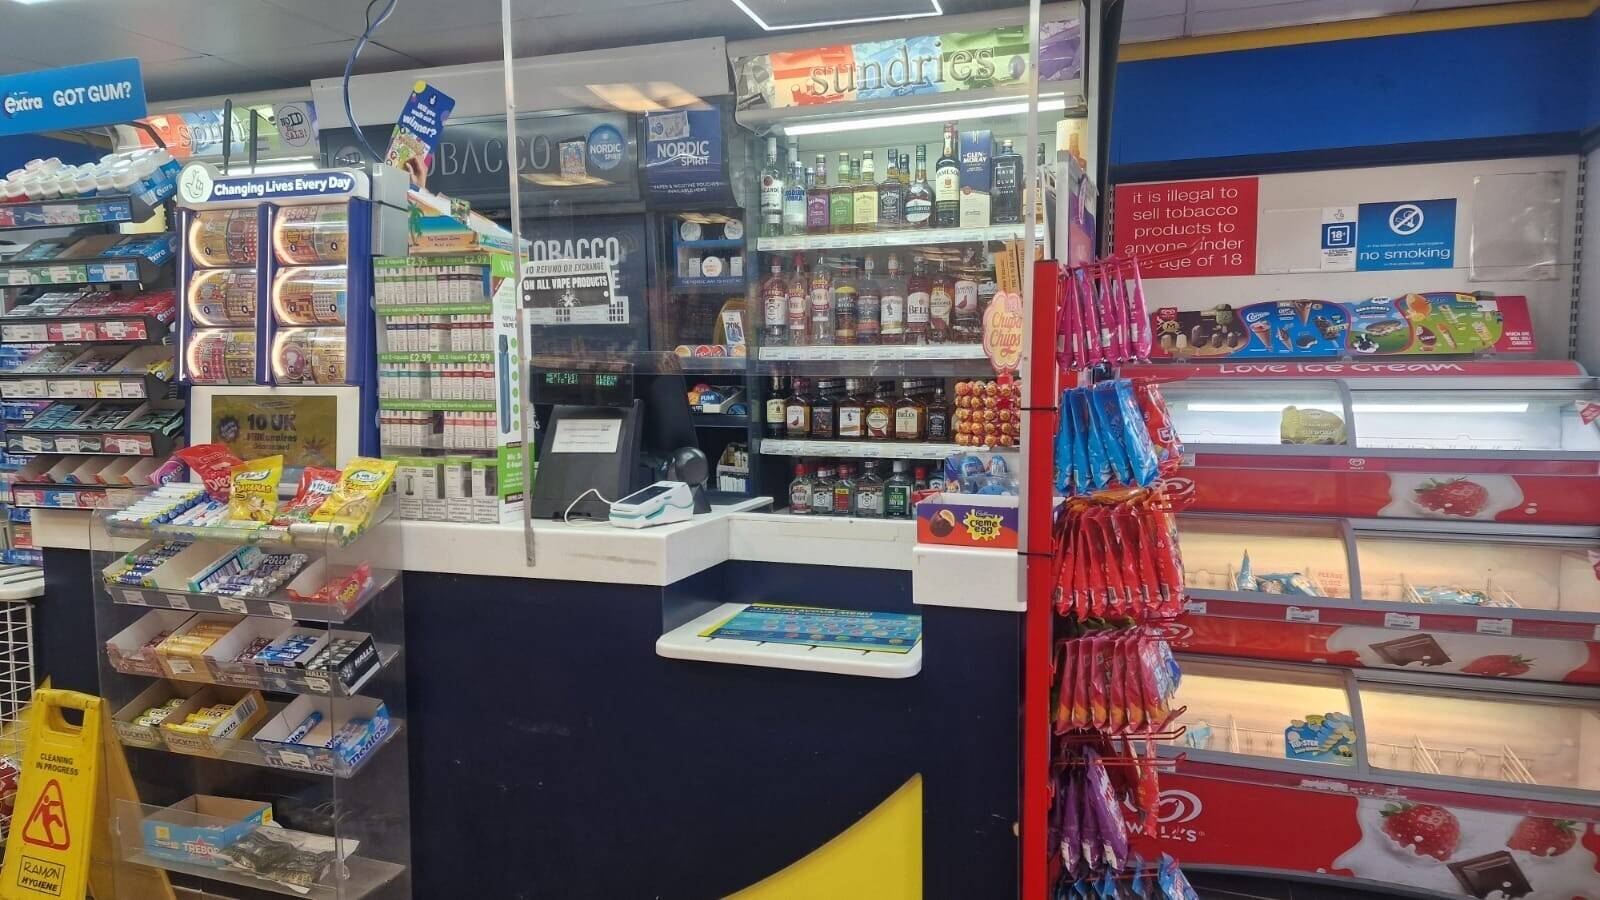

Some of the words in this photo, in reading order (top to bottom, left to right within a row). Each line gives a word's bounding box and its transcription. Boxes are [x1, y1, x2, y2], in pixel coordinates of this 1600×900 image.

[808, 40, 995, 95] sundries
[5, 95, 43, 114] extra
[53, 87, 85, 107] GOT
[88, 81, 131, 103] GUM?
[402, 115, 437, 138] winner?
[590, 143, 621, 154] NORDIC
[657, 141, 709, 158] NORDIC
[680, 156, 709, 166] SPIRIT
[214, 182, 264, 197] Changing
[265, 180, 294, 194] Lives
[295, 177, 327, 192] Every
[328, 176, 351, 190] Day
[1133, 192, 1142, 203] it
[1148, 191, 1161, 203] is
[1167, 187, 1214, 203] illegal
[1220, 188, 1238, 199] to
[1133, 208, 1159, 221] sell
[1166, 206, 1238, 219] tobacco
[1134, 223, 1212, 240] products
[1218, 221, 1235, 233] to
[1125, 242, 1187, 256] anyone
[1360, 252, 1379, 260] no
[1385, 248, 1450, 260] smoking
[1197, 255, 1215, 267] of
[1223, 253, 1242, 266] 18
[536, 264, 562, 274] REFUND
[574, 262, 604, 272] EXCHANGE
[523, 280, 535, 290] ON
[536, 279, 551, 290] ALL
[552, 278, 571, 289] VAPE
[572, 276, 608, 289] PRODUCTS
[990, 330, 1021, 347] Chups
[409, 354, 431, 363] £2.99
[467, 353, 490, 363] £2.99
[271, 413, 297, 431] UK
[974, 526, 993, 535] egg
[354, 643, 375, 667] HALLS
[264, 666, 286, 674] HALLS
[349, 725, 388, 767] mentos
[40, 753, 74, 765] CLEANING
[43, 764, 79, 776] PROGRESS
[1125, 822, 1197, 842] WLL'S
[24, 861, 61, 880] RAMON
[21, 877, 58, 892] HYGIENE
